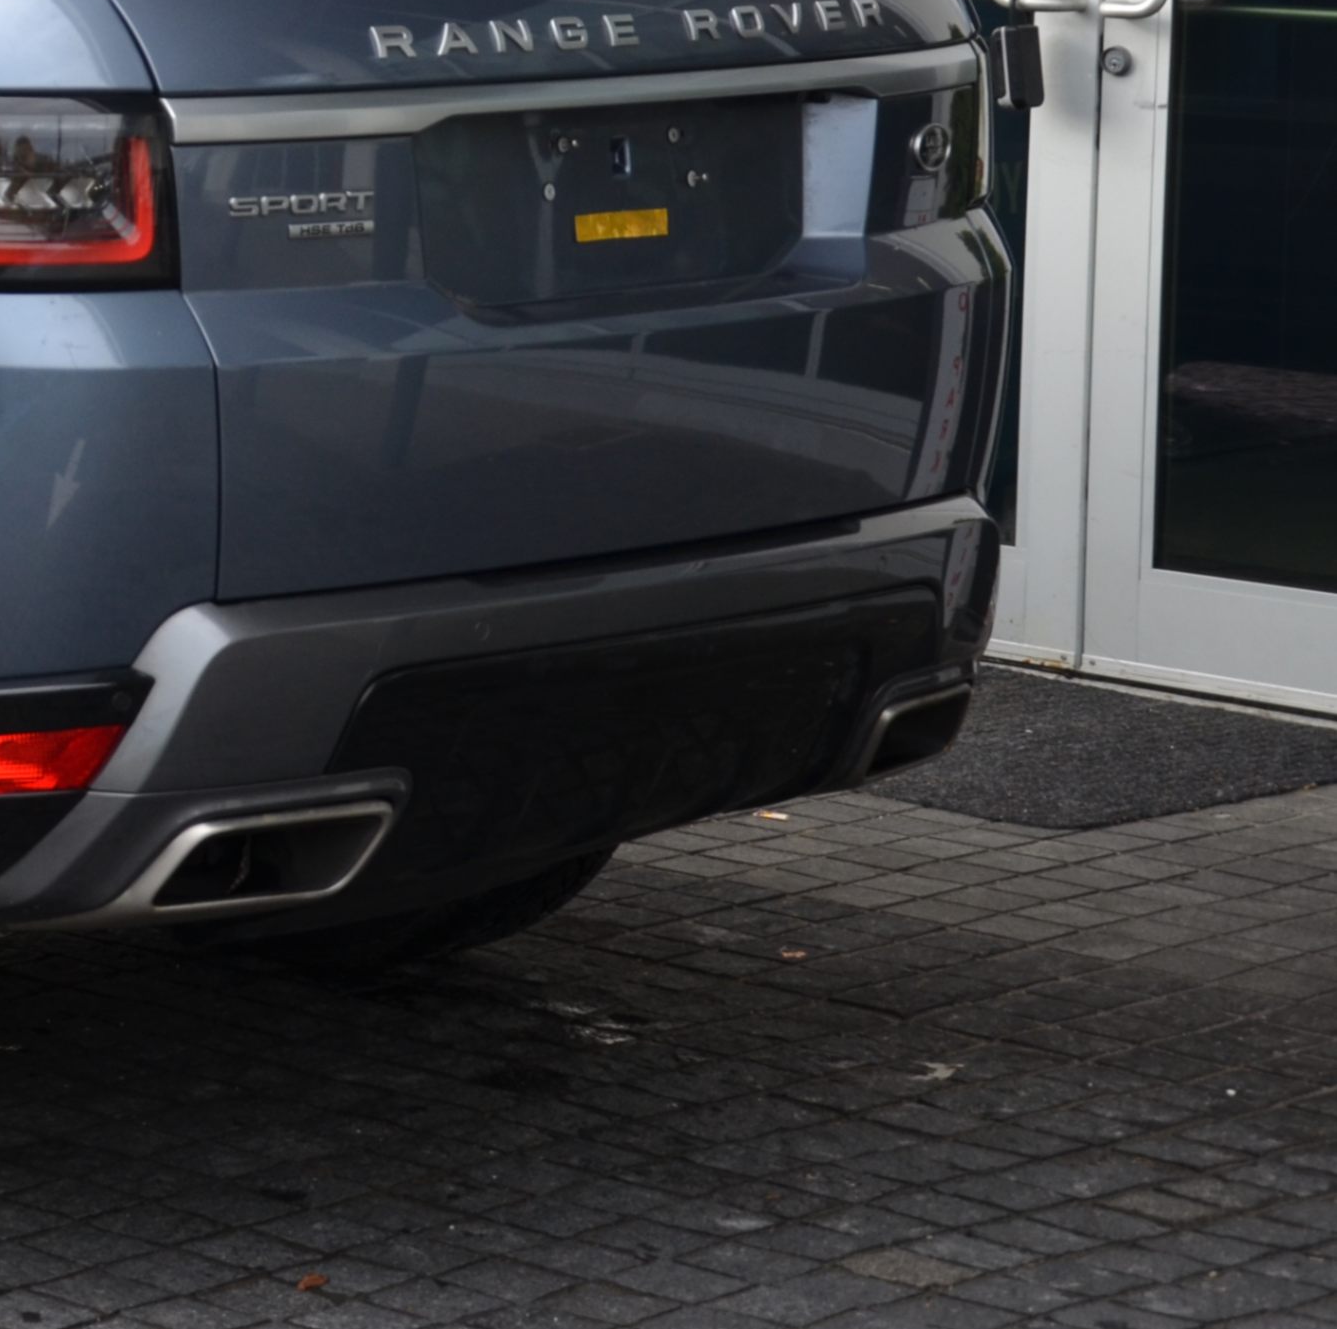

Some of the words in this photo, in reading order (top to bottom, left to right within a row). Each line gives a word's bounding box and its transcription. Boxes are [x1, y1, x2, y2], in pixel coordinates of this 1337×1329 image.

[369, 13, 640, 59] RANGE
[228, 190, 375, 218] SPORT
[299, 225, 332, 237] HSE
